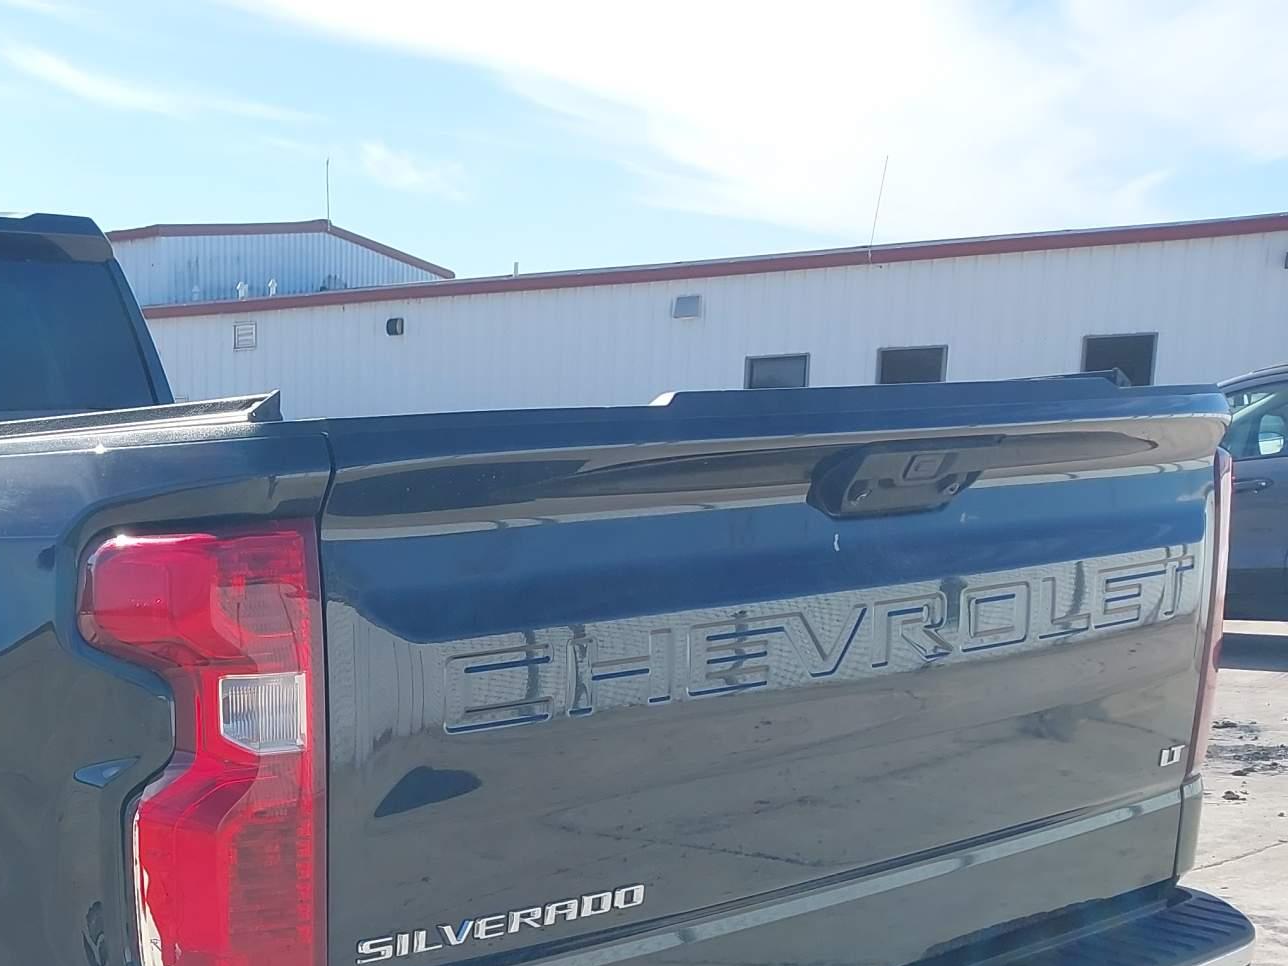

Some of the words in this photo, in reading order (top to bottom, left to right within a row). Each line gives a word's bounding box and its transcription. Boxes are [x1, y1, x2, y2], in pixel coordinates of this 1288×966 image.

[444, 553, 1195, 735] CHEVROLET
[1159, 744, 1186, 767] LT
[356, 884, 645, 964] SILVERADO
